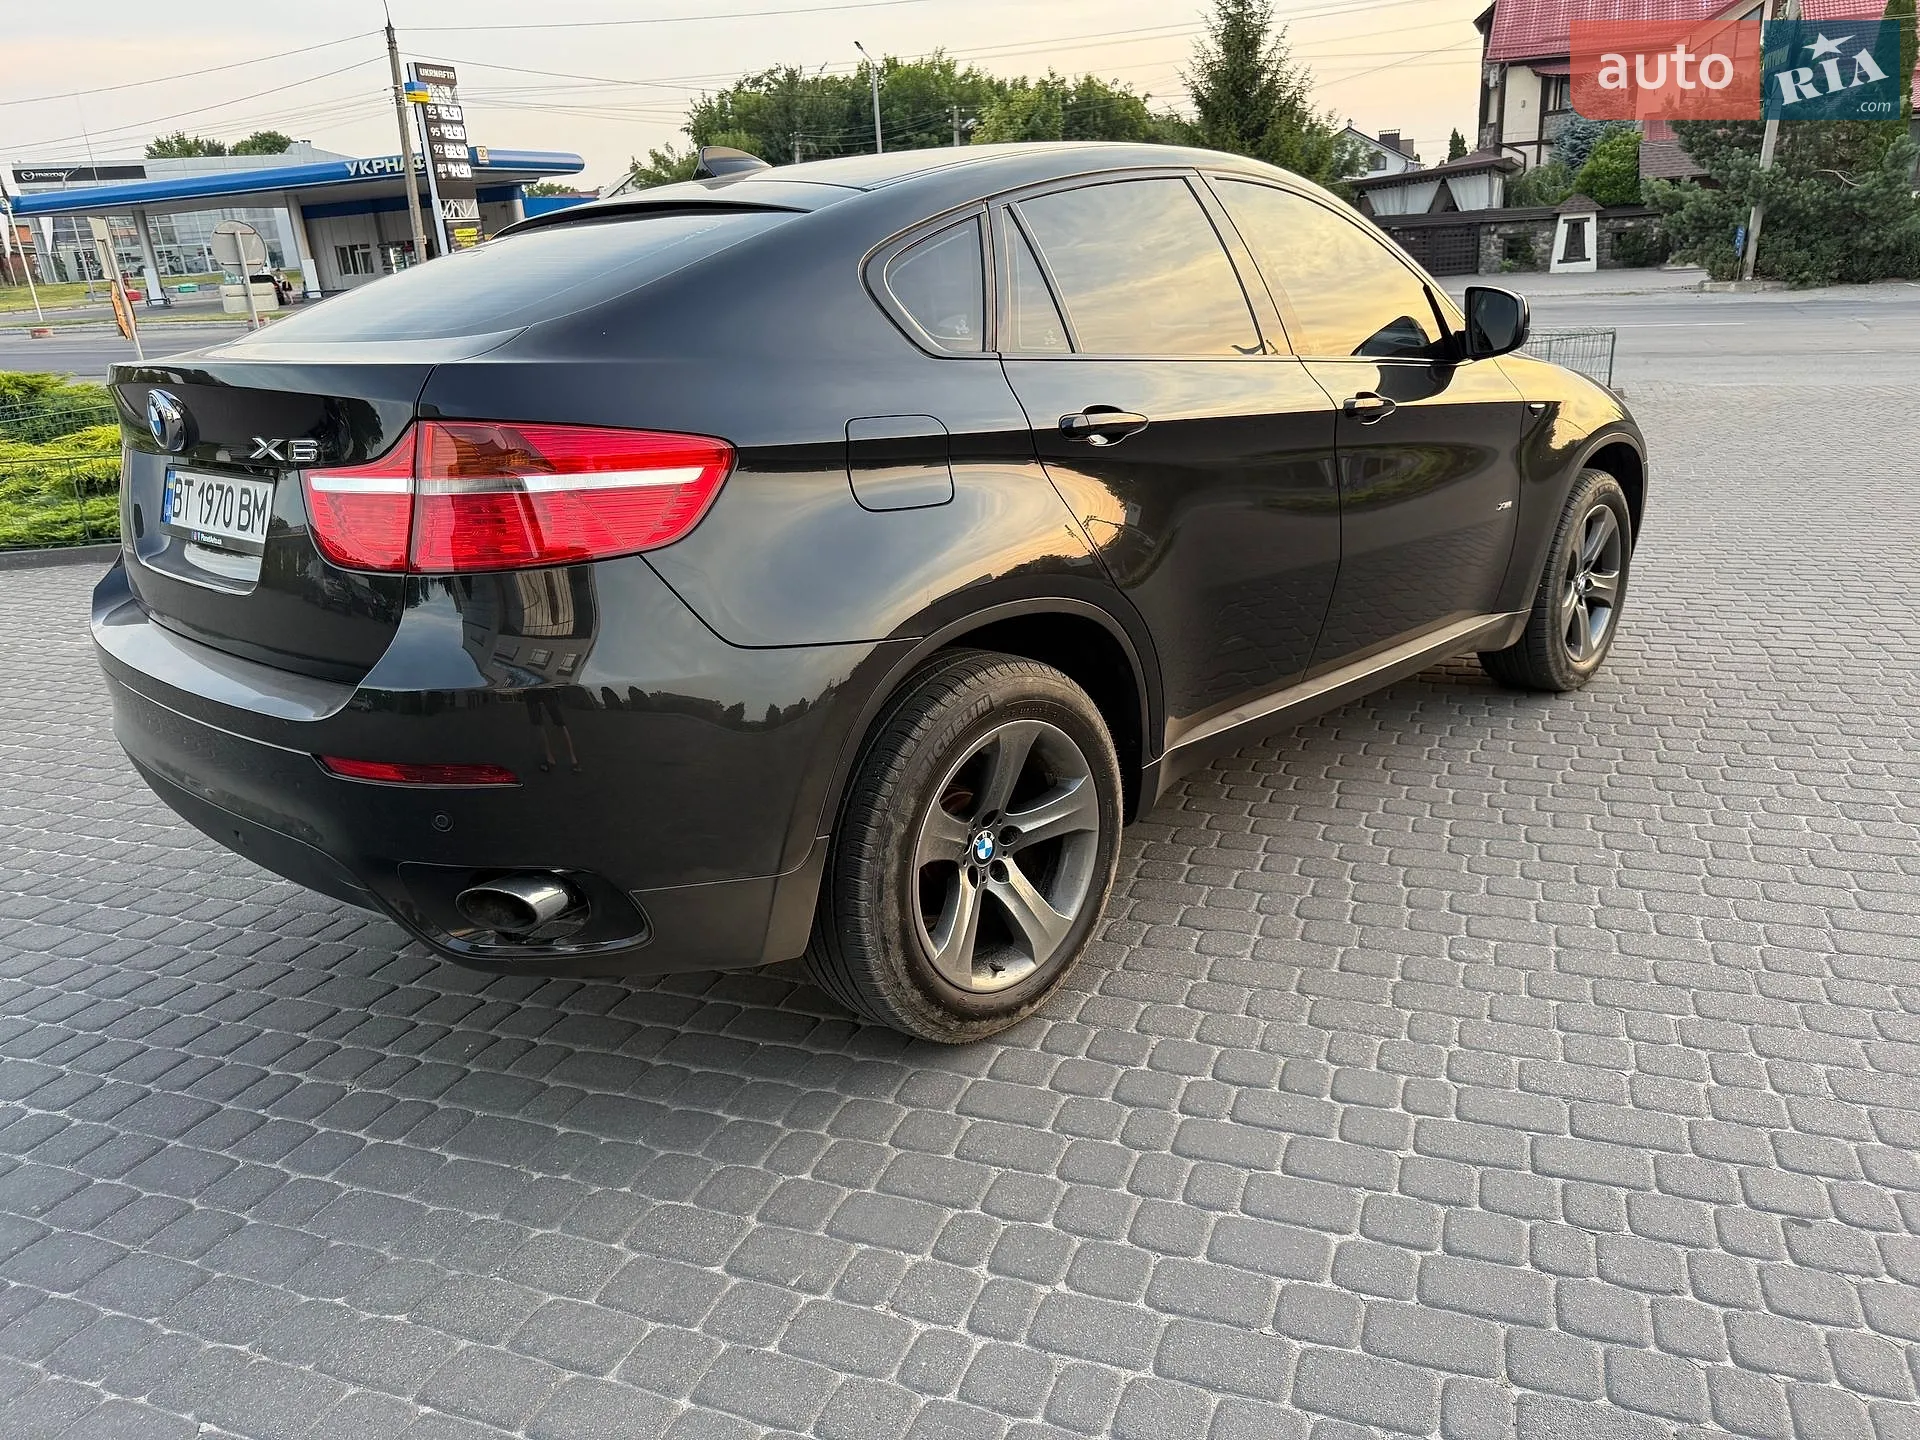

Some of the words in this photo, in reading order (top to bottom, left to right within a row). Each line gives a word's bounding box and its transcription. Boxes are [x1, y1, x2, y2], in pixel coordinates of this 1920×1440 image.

[427, 105, 437, 114] 95
[431, 127, 440, 136] 95
[434, 144, 444, 154] 92
[250, 437, 318, 462] X6
[172, 477, 194, 521] BT
[198, 481, 234, 528] 1970
[237, 487, 268, 535] BM
